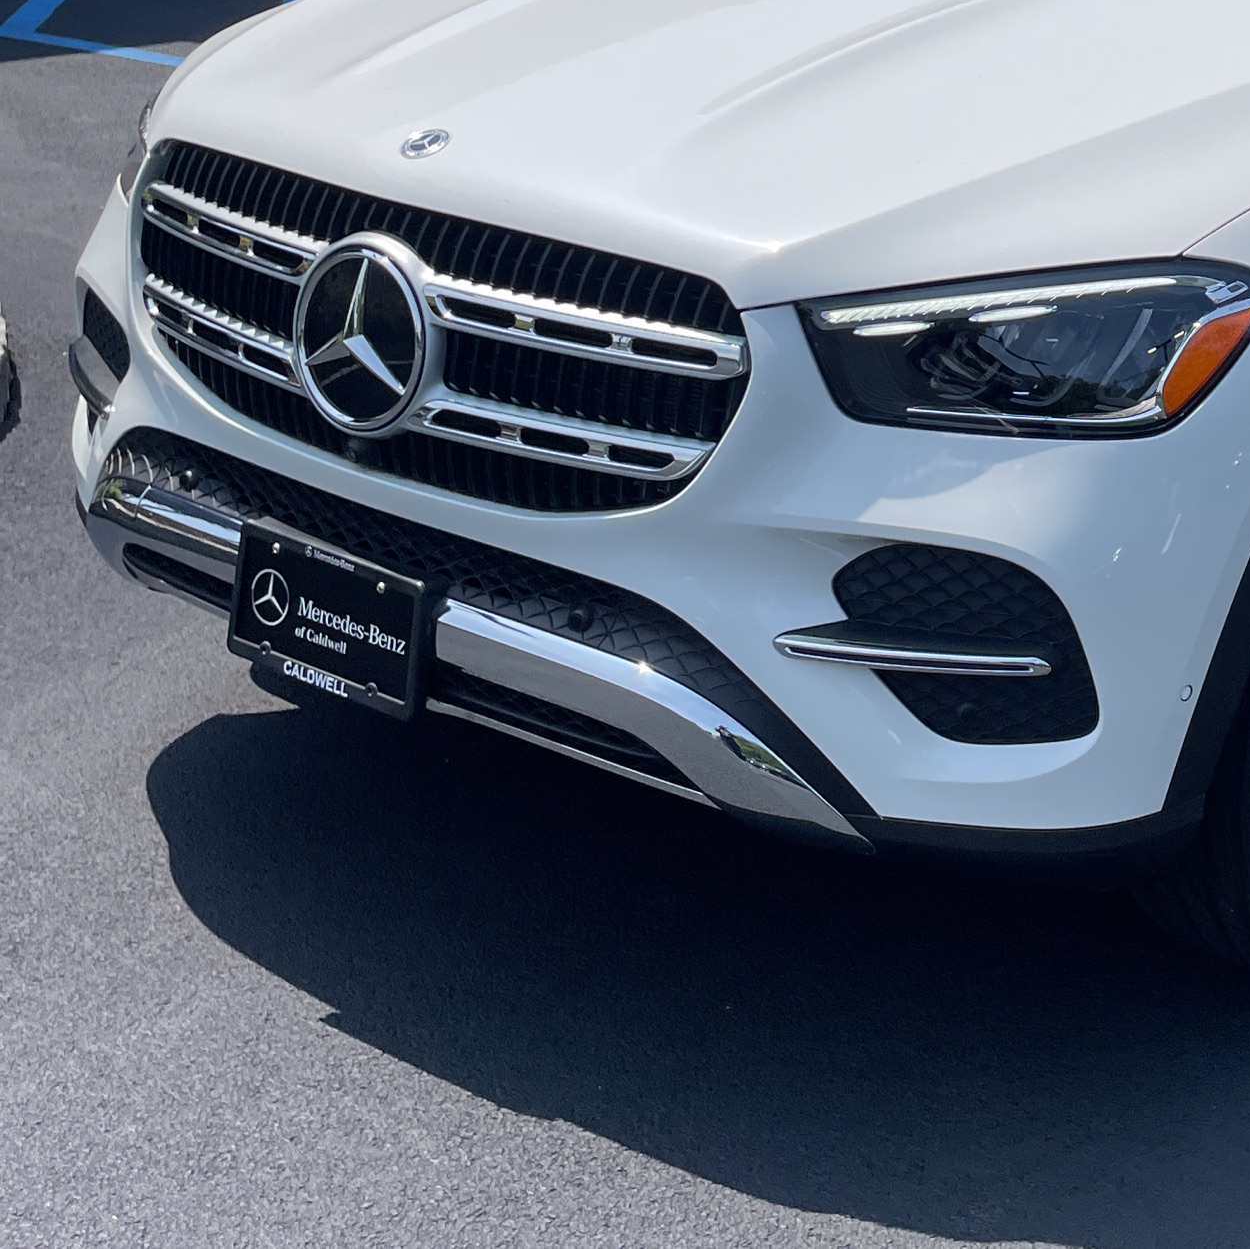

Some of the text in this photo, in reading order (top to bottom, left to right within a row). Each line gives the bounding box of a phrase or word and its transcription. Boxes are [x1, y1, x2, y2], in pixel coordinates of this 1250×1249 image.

[294, 626, 347, 655] of Caldwell
[297, 596, 406, 656] Mercedes-Benz
[283, 660, 349, 698] CALDWELL
